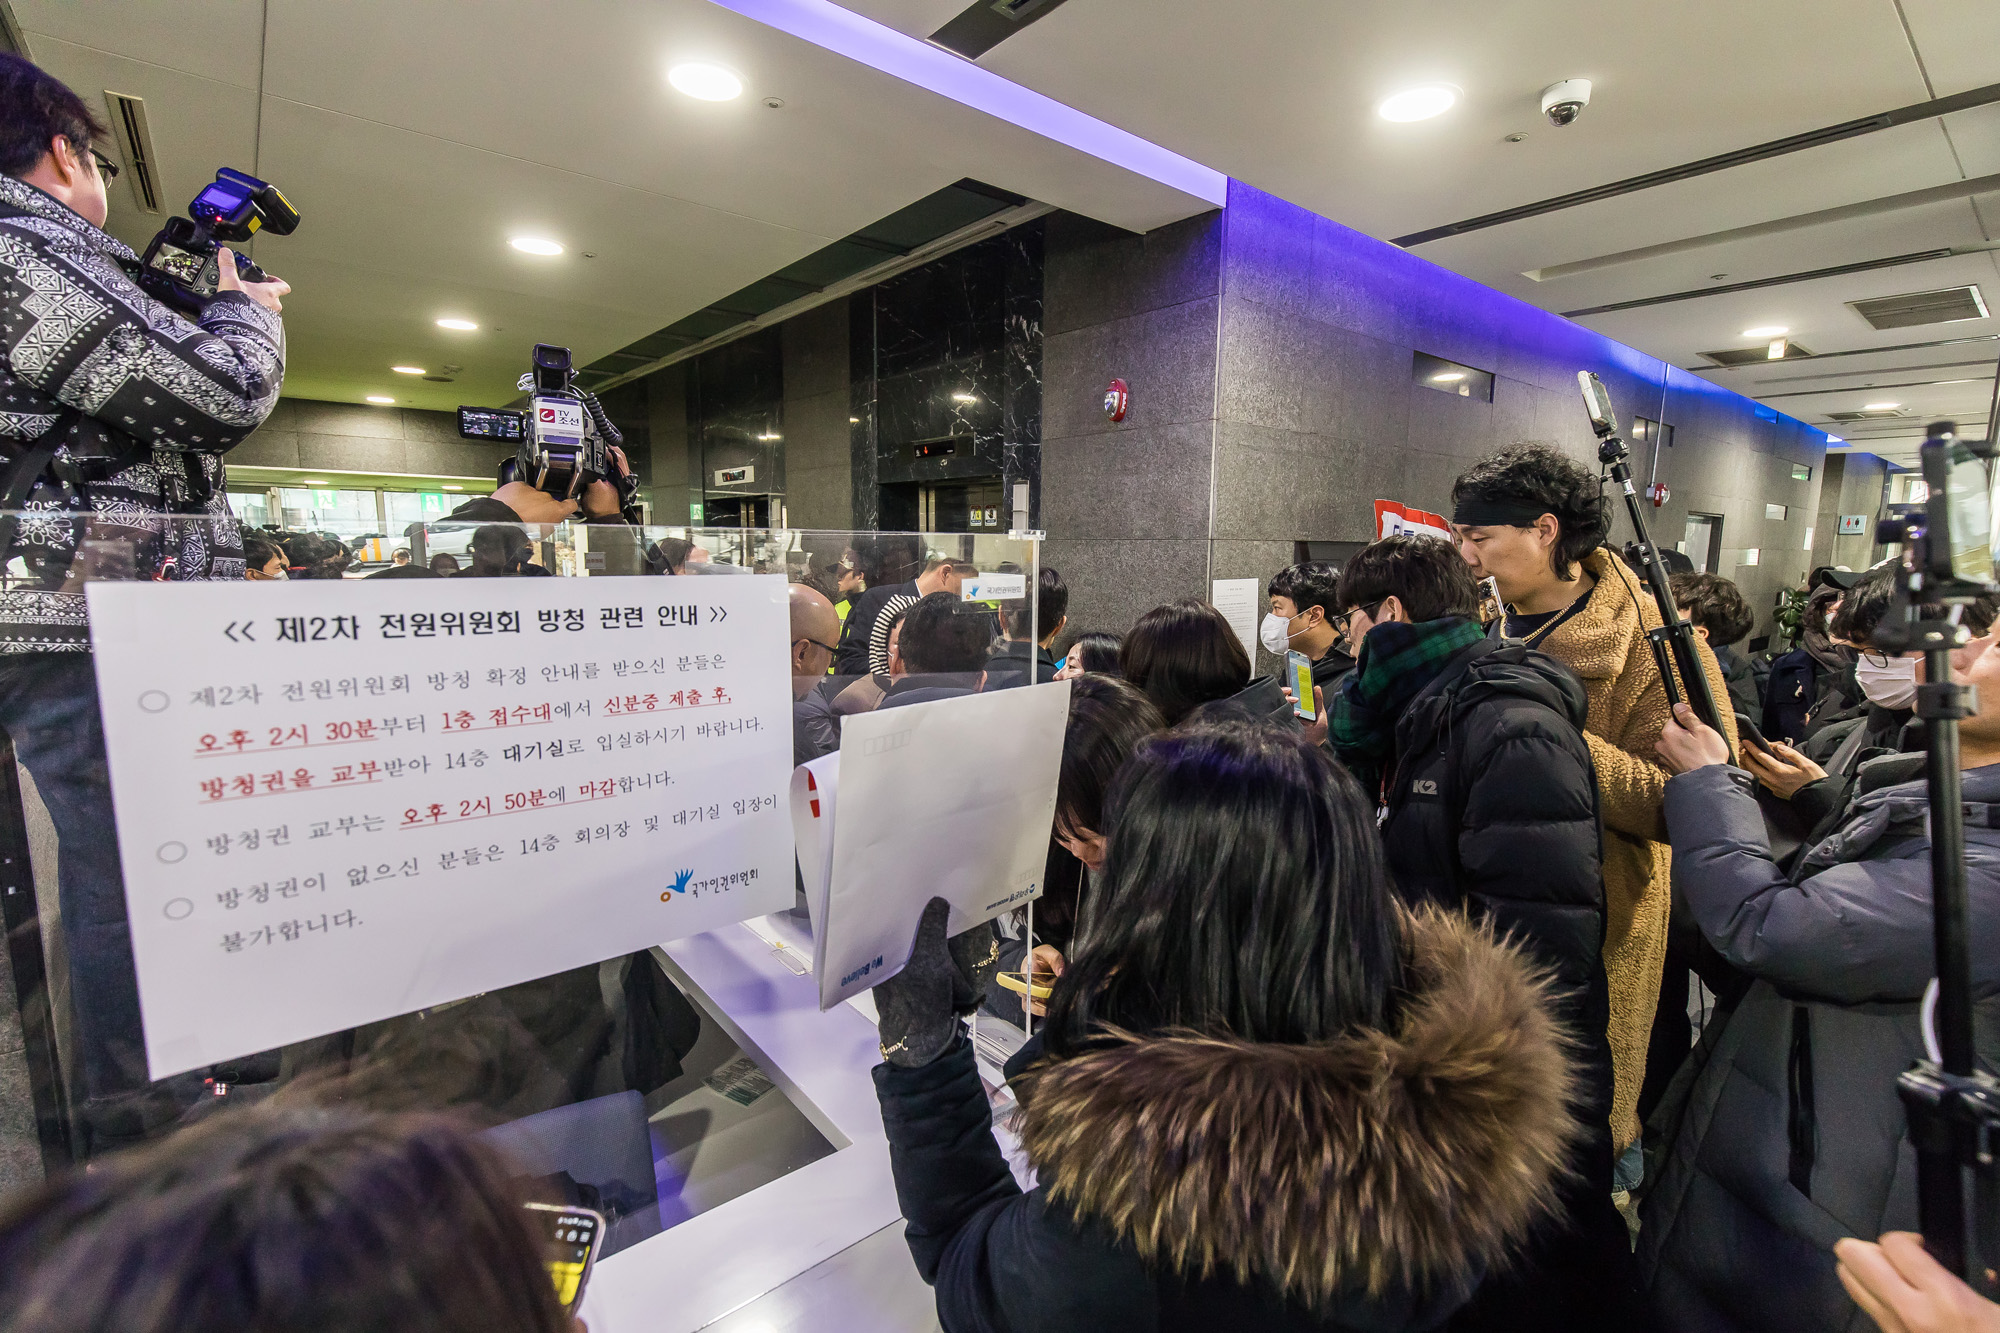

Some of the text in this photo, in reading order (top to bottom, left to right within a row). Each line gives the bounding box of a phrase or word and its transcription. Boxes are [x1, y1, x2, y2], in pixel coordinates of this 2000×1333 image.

[558, 417, 579, 426] 조선
[275, 615, 360, 643] 제2차
[379, 610, 521, 639] 전원위원회
[538, 608, 585, 633] 방청
[599, 607, 644, 629] 관련
[657, 605, 698, 627] 안내
[189, 653, 727, 708] 제2차 전원위원회 방청 확정 안내를 받으신 분들은
[196, 686, 732, 752] 오후 2시 30분부터 1층 접수대에서 신분증 제출 후,
[200, 717, 765, 801] 방청권을 교부받아 14층 대기실로 입실하시기 바랍니다.
[1412, 779, 1438, 795] K2
[206, 770, 676, 856] 방청권 교부는 오후 2시 50분에 마감합니다.
[217, 794, 778, 910] 방청권이 없으신 분들은 14층 회의장 및 대기실 입장이
[692, 868, 759, 899] 국가인권위원회
[219, 908, 364, 954] 불가합니다.
